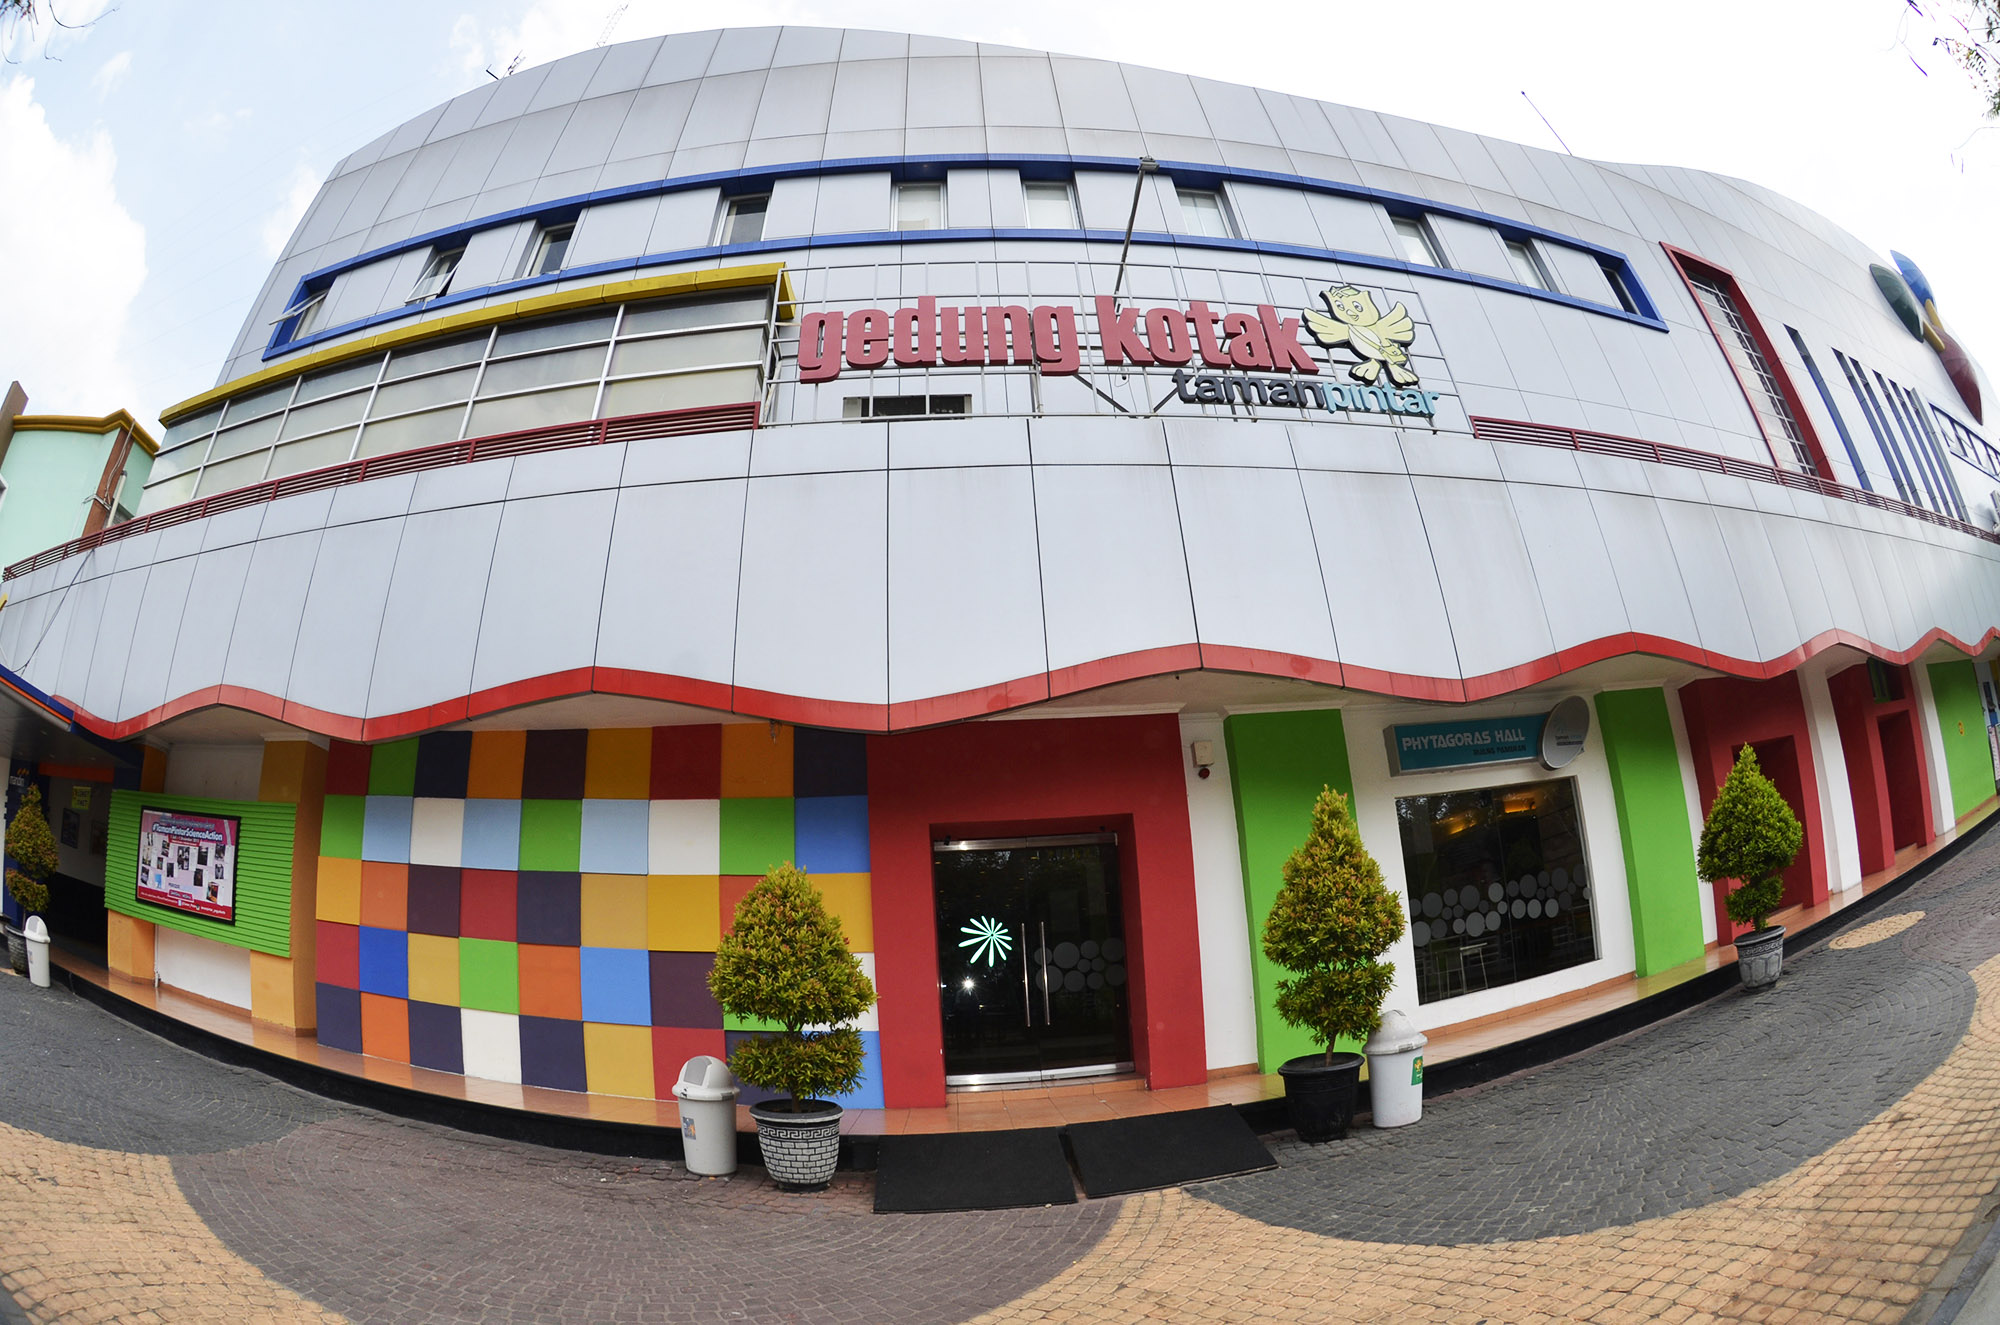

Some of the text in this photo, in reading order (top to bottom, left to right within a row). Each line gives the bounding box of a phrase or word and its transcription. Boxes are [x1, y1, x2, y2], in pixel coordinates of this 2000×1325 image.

[799, 295, 1320, 384] gedung kotak
[1402, 728, 1526, 751] PHYTAGORAS HALL
